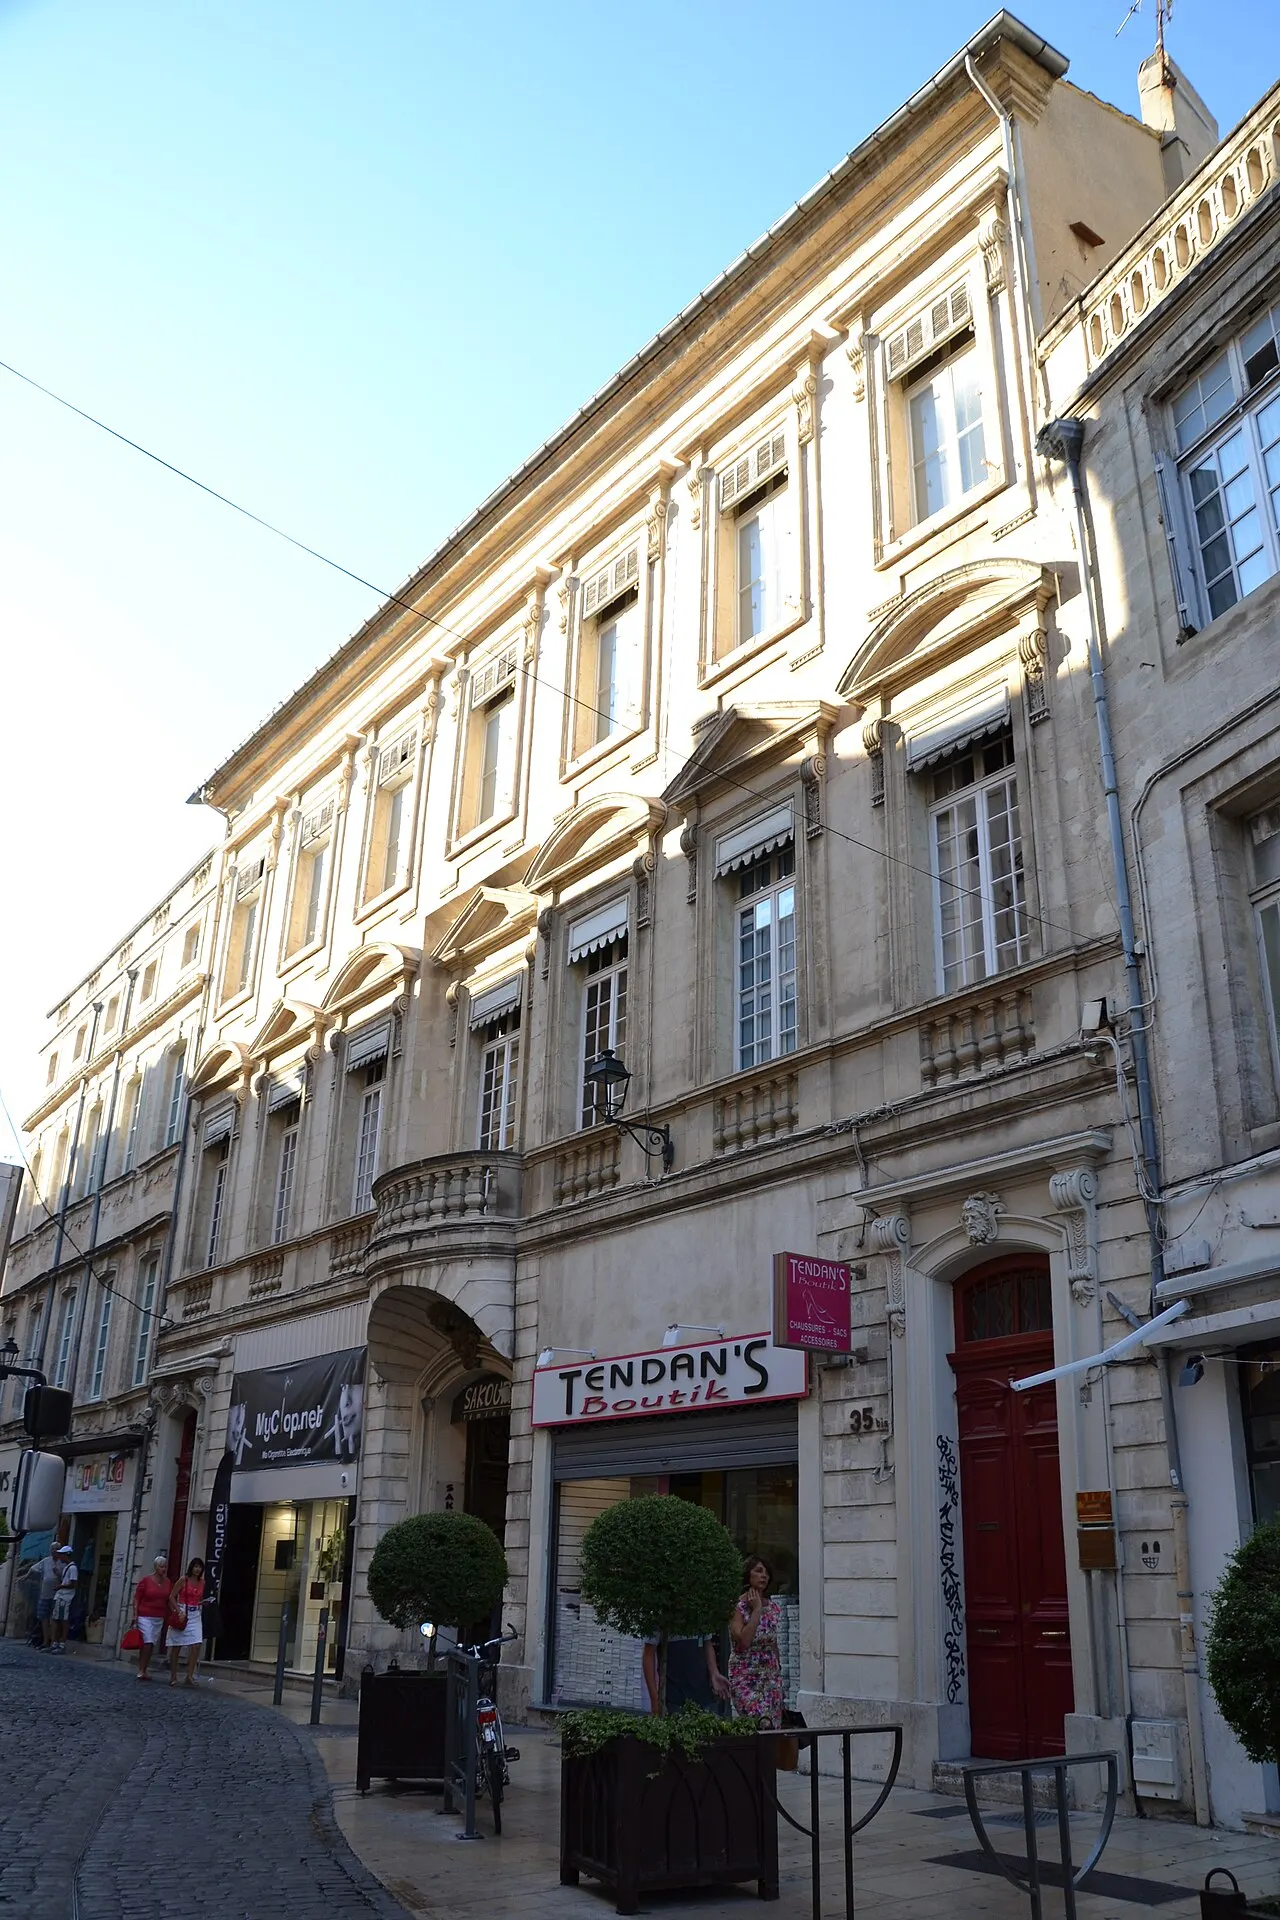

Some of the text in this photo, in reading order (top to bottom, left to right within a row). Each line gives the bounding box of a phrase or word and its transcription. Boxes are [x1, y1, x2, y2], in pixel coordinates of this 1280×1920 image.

[789, 1258, 847, 1291] TENDAN'S
[798, 1276, 838, 1291] Boutik
[789, 1319, 826, 1334] CHAUSSURES
[833, 1327, 848, 1338] SACS
[800, 1334, 838, 1348] ACCESSOIRES
[559, 1339, 768, 1415] TENDAN'S
[580, 1379, 729, 1416] Boutik
[850, 1406, 889, 1433] 35 bis
